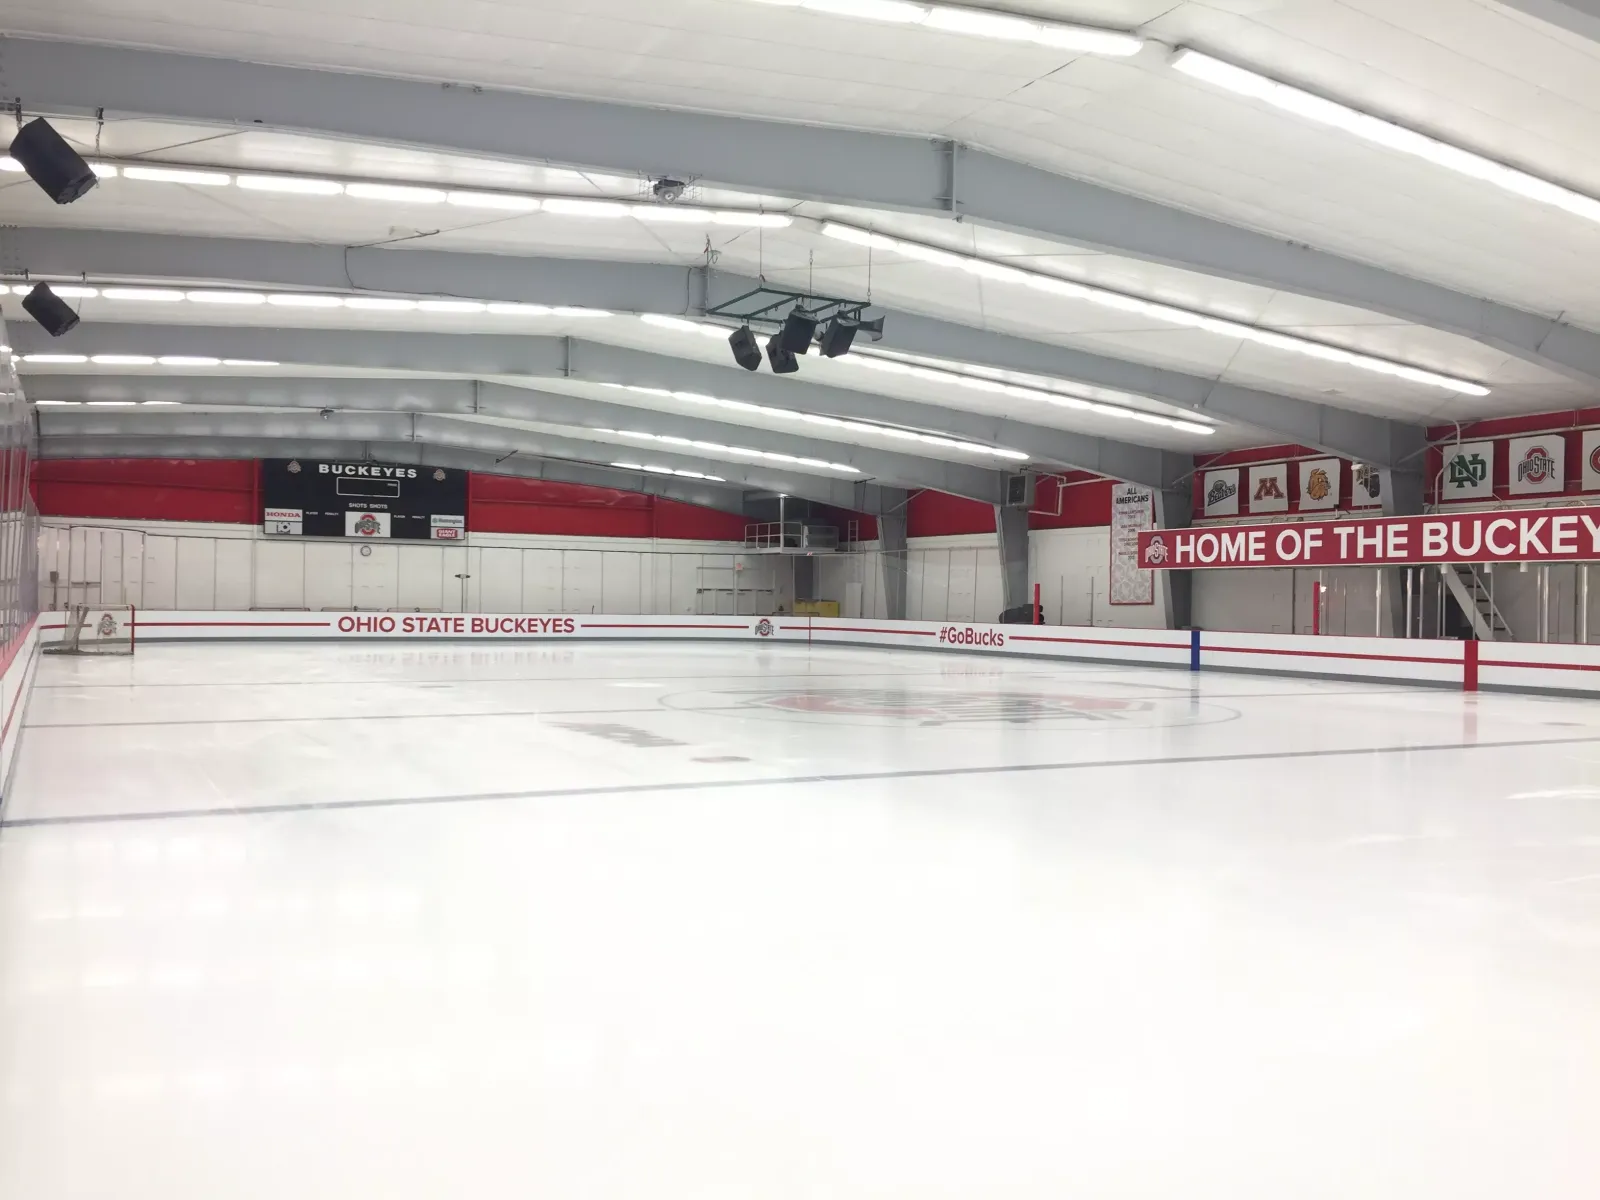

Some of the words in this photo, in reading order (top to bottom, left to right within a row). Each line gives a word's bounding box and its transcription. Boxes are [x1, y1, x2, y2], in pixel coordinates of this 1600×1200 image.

[318, 464, 418, 478] BUCKEYES
[1127, 487, 1137, 495] ALL
[1253, 476, 1285, 500] M
[1116, 494, 1149, 505] AMERICANS
[1175, 531, 1266, 564] HOME
[1275, 527, 1323, 561] OF
[1333, 523, 1409, 560] THE
[1422, 515, 1600, 557] BUCKEY
[338, 616, 396, 633] OHIO
[402, 617, 465, 633] STATE
[471, 617, 575, 634] BUCKEYES
[939, 626, 1004, 647] #GoBucks
